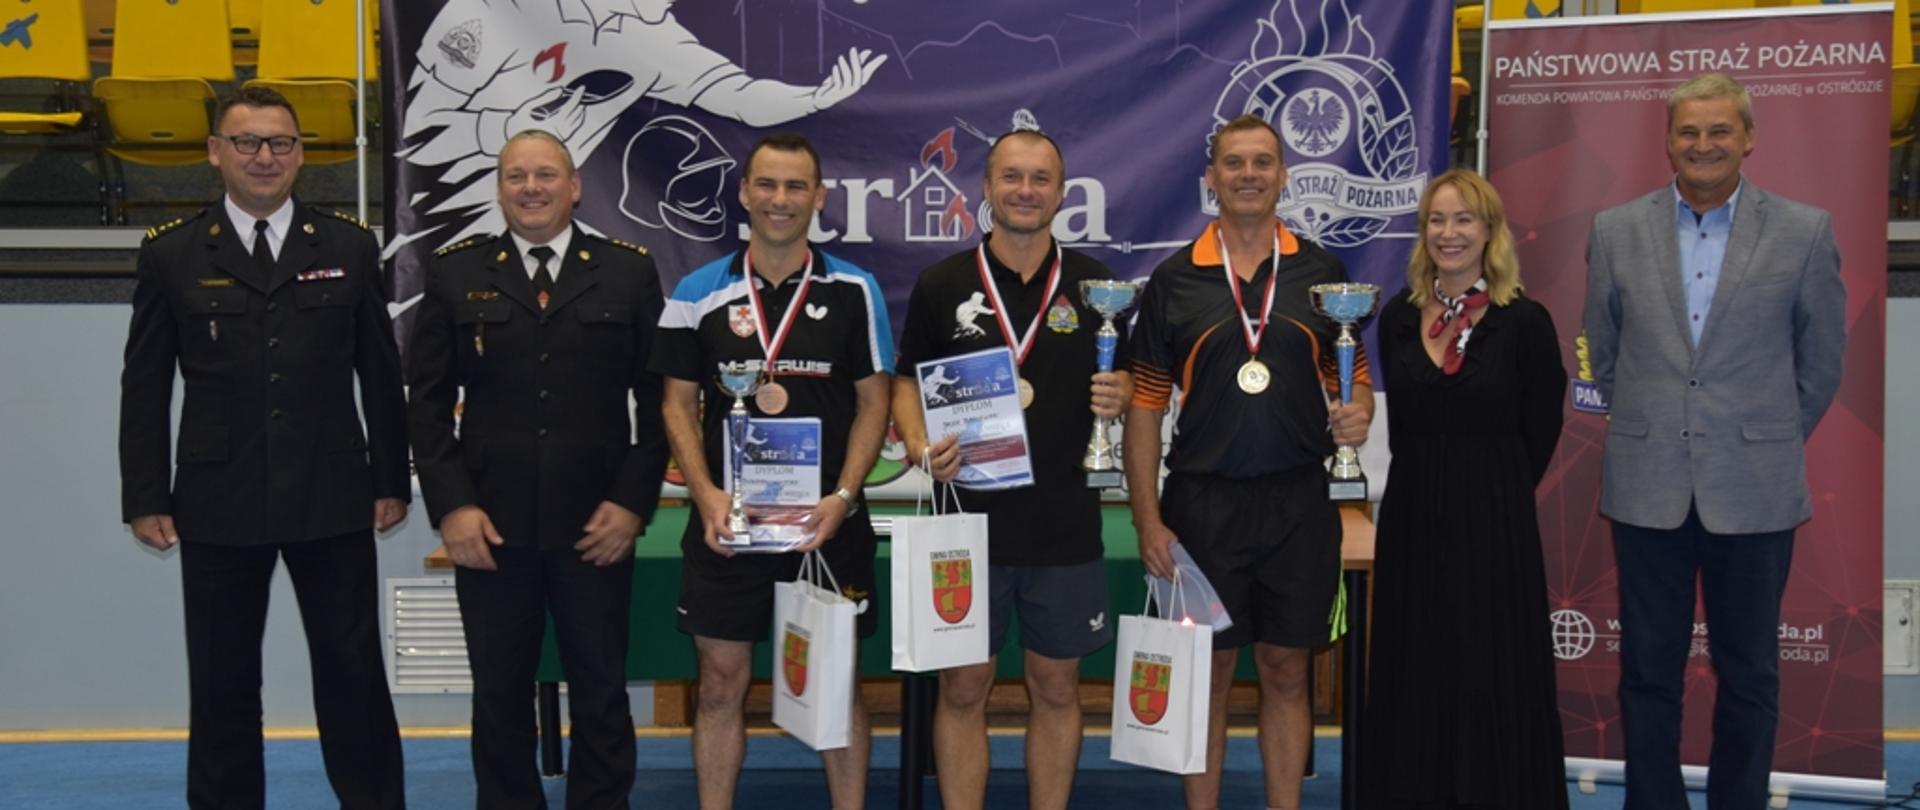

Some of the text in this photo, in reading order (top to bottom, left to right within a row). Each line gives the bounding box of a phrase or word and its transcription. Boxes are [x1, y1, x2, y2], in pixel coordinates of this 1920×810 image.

[1495, 40, 1886, 79] PAŃSTWOWA STRAŻ POŻARNA
[1496, 93, 1551, 106] KOMENDA
[1553, 90, 1620, 104] POWIATOWA
[1624, 87, 1677, 101] PAŃSTWO
[1817, 79, 1884, 95] OSTRÓDZIE
[1297, 175, 1338, 197] STRAŻ
[1347, 186, 1418, 208] POŻARNA
[952, 400, 993, 415] DYPLOM
